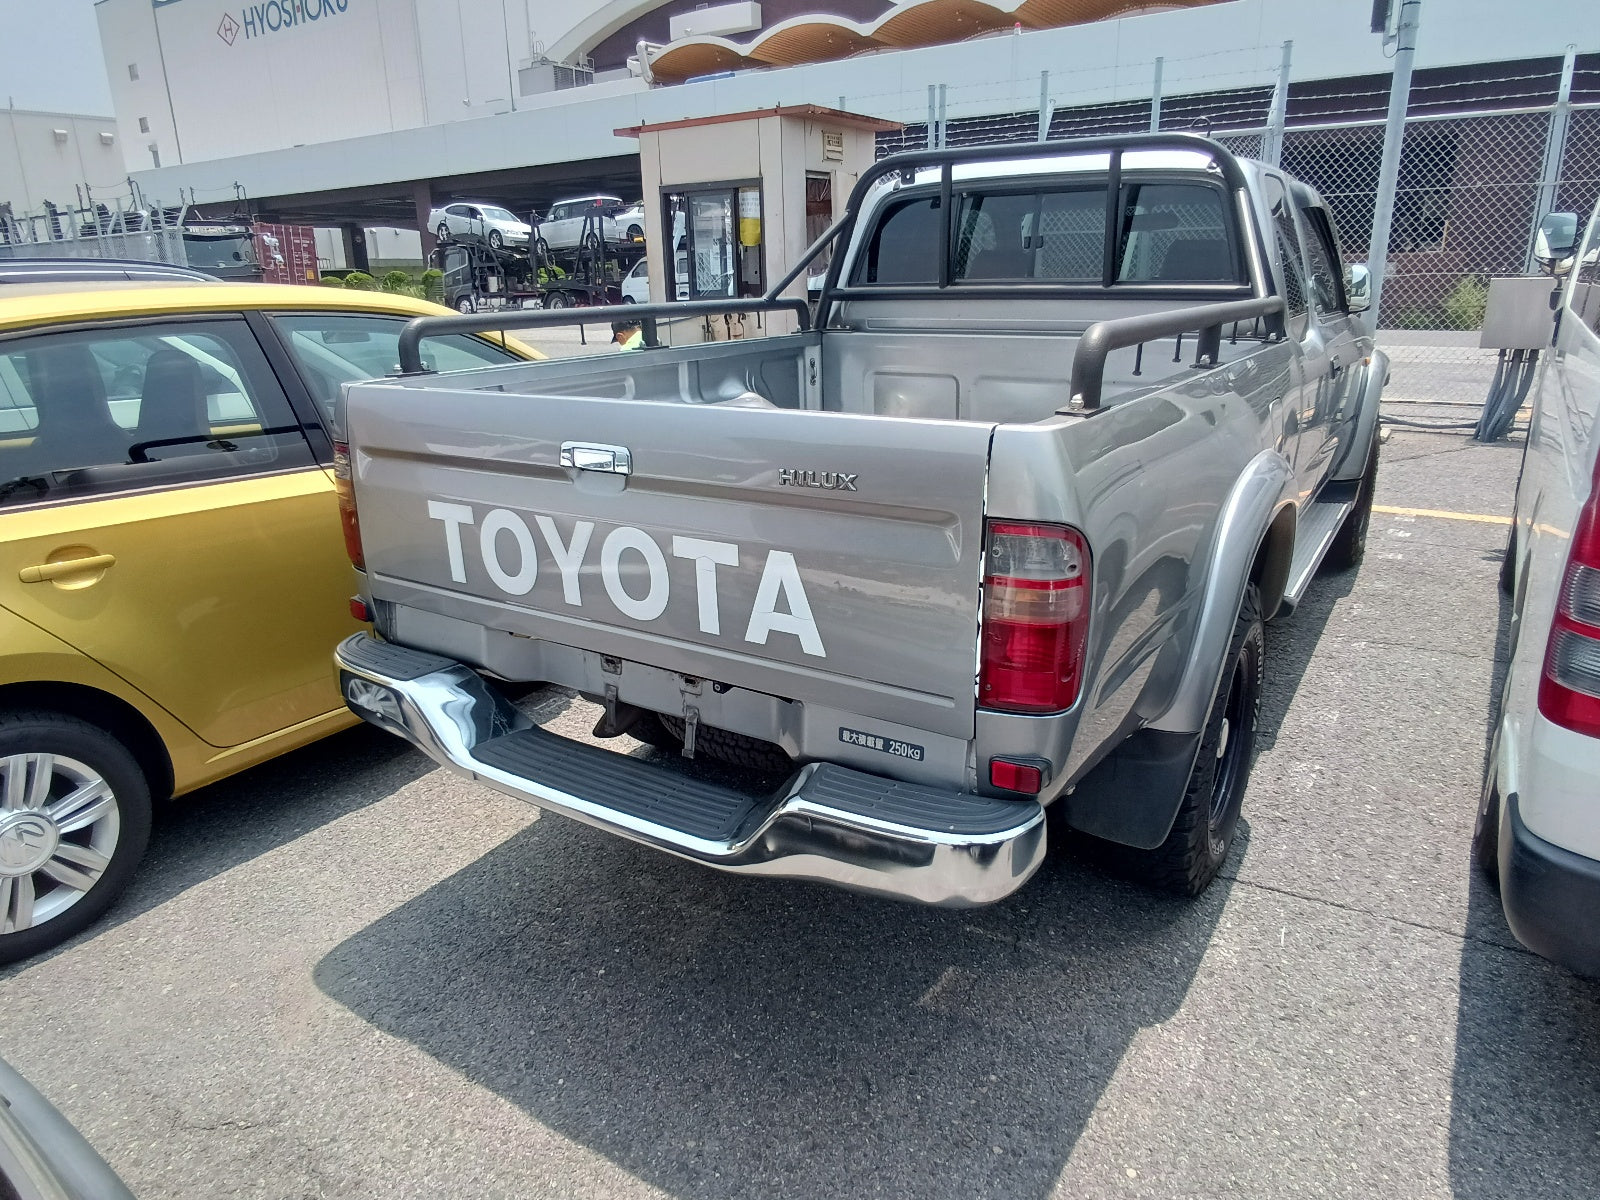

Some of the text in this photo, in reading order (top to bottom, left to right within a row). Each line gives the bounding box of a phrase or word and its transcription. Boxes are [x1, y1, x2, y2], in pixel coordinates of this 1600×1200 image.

[778, 468, 858, 491] HILUX
[427, 500, 827, 658] TOYOTA
[888, 741, 921, 760] 250kg
